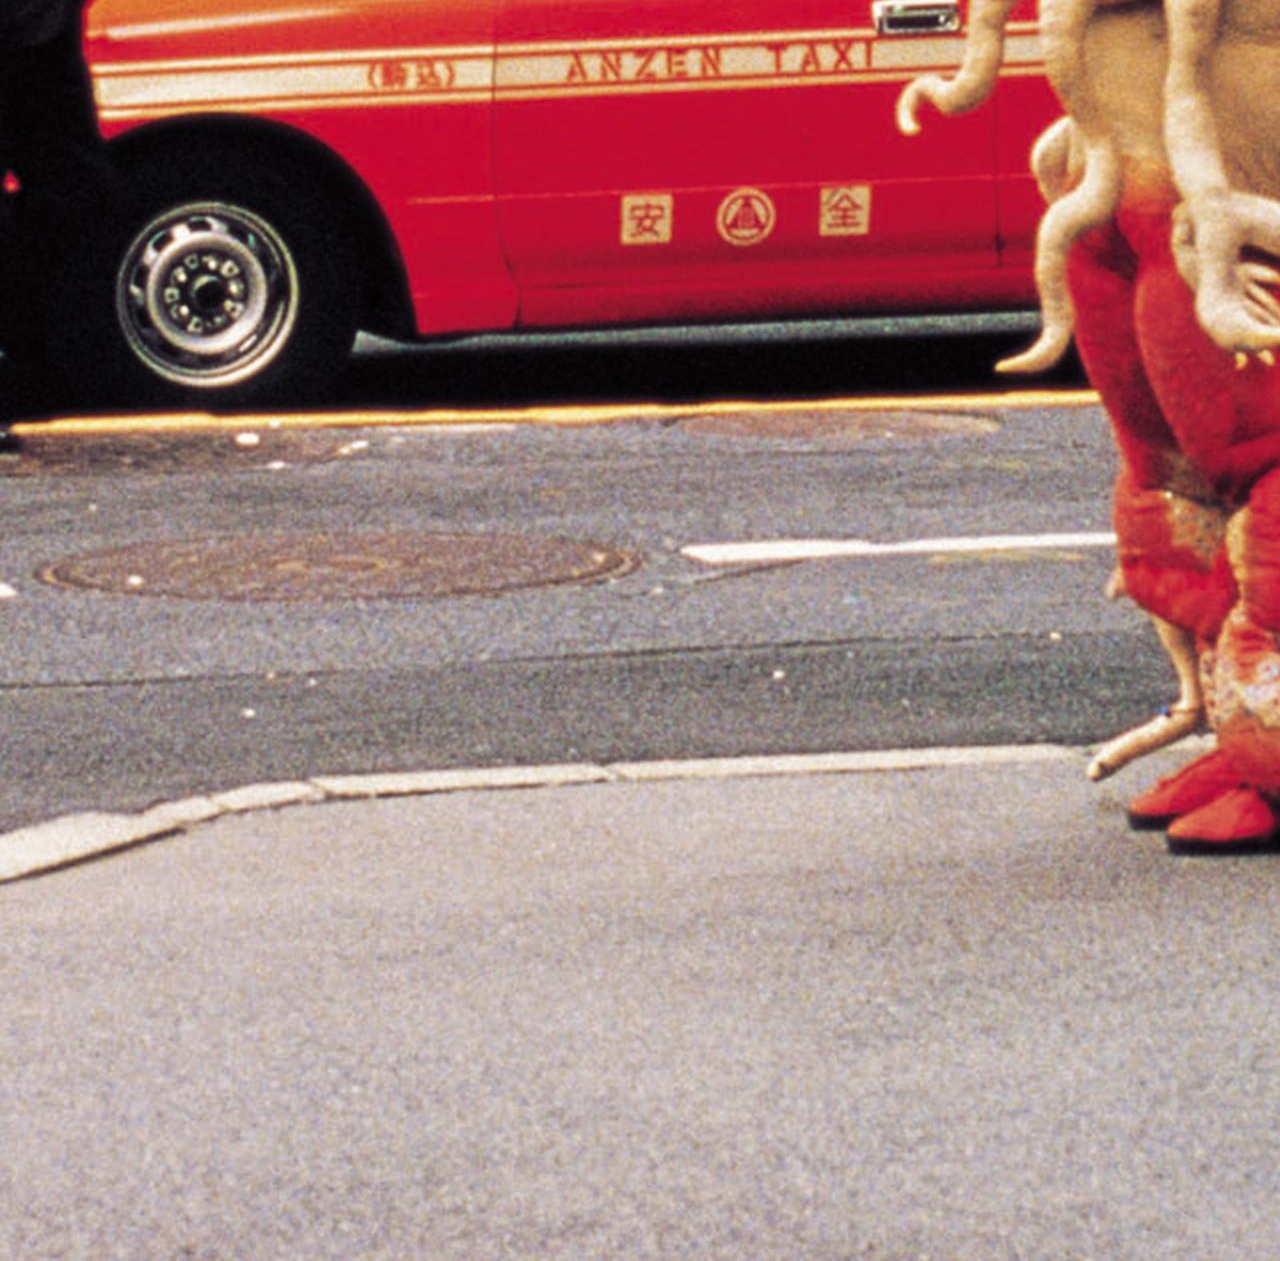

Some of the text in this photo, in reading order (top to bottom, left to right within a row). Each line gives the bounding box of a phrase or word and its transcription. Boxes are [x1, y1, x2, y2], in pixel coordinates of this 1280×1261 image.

[565, 40, 871, 82] ANZEN TAXI
[628, 192, 863, 237] 安 全
